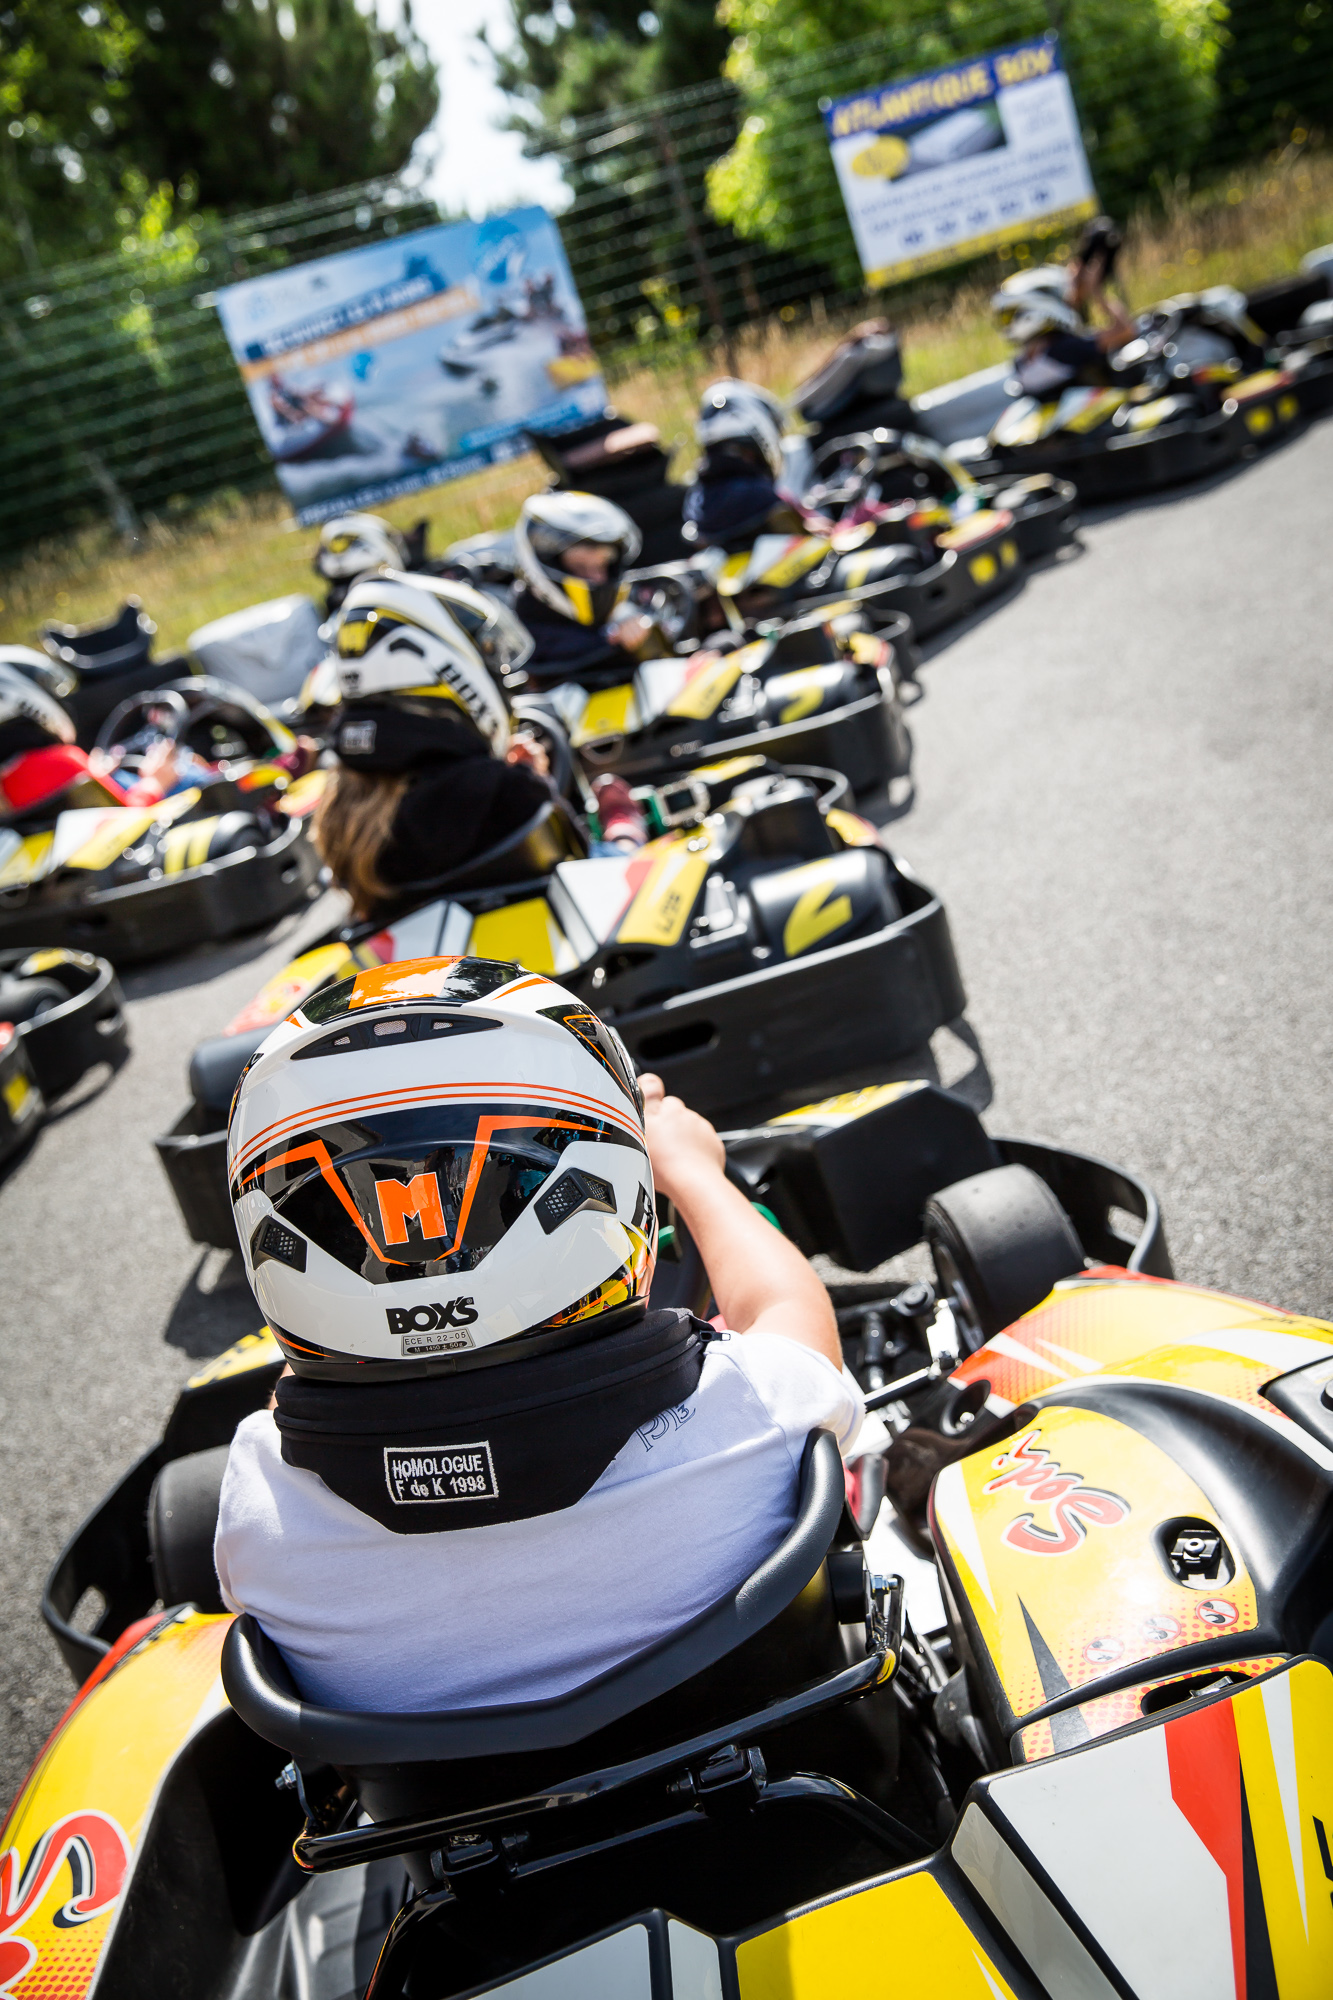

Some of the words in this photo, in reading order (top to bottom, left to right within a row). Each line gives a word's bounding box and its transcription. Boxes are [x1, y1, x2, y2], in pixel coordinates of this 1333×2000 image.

[375, 1171, 447, 1246] M
[385, 1296, 479, 1334] BOX'S
[404, 1337, 423, 1346] ECE
[436, 1331, 466, 1342] 22-05
[392, 1455, 484, 1480] HOMOLOGUE
[395, 1480, 405, 1500] F
[410, 1479, 430, 1497] de
[431, 1478, 446, 1496] K
[450, 1475, 487, 1495] 1998
[982, 1428, 1132, 1558] Sodi
